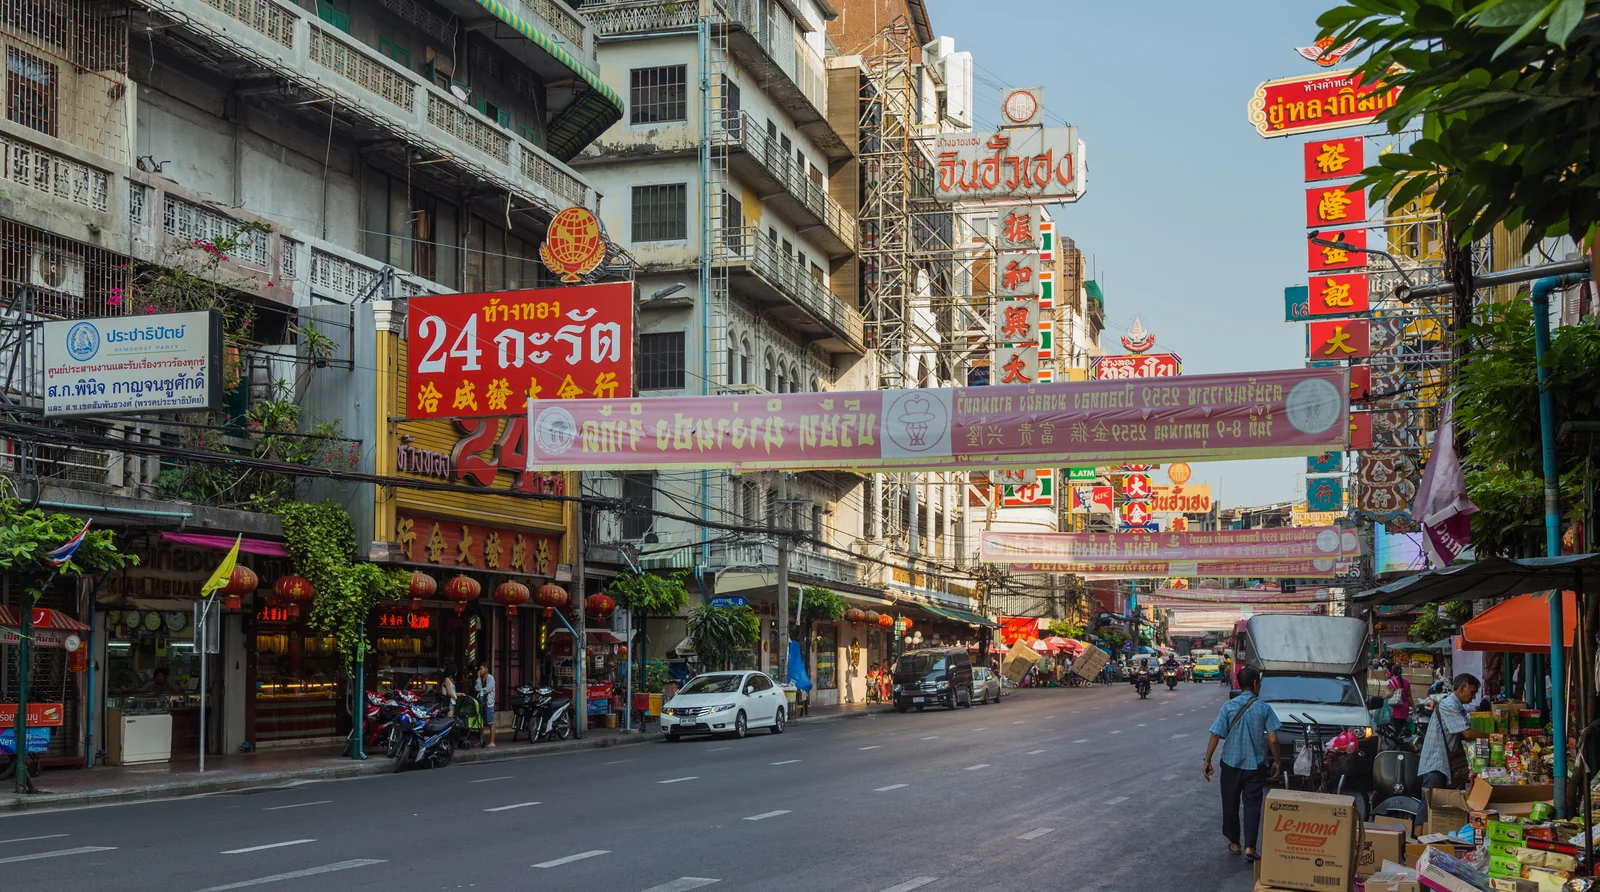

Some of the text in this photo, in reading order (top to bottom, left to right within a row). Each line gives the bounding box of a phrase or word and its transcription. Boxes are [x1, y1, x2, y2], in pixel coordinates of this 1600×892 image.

[482, 298, 560, 323] ห้างทอง
[106, 324, 187, 343] ประชาธิปัตย์
[417, 307, 621, 374] 24 กะรัต
[114, 345, 152, 353] DEMOCRAT
[1094, 491, 1110, 501] KFC
[1274, 813, 1341, 836] Le-mond
